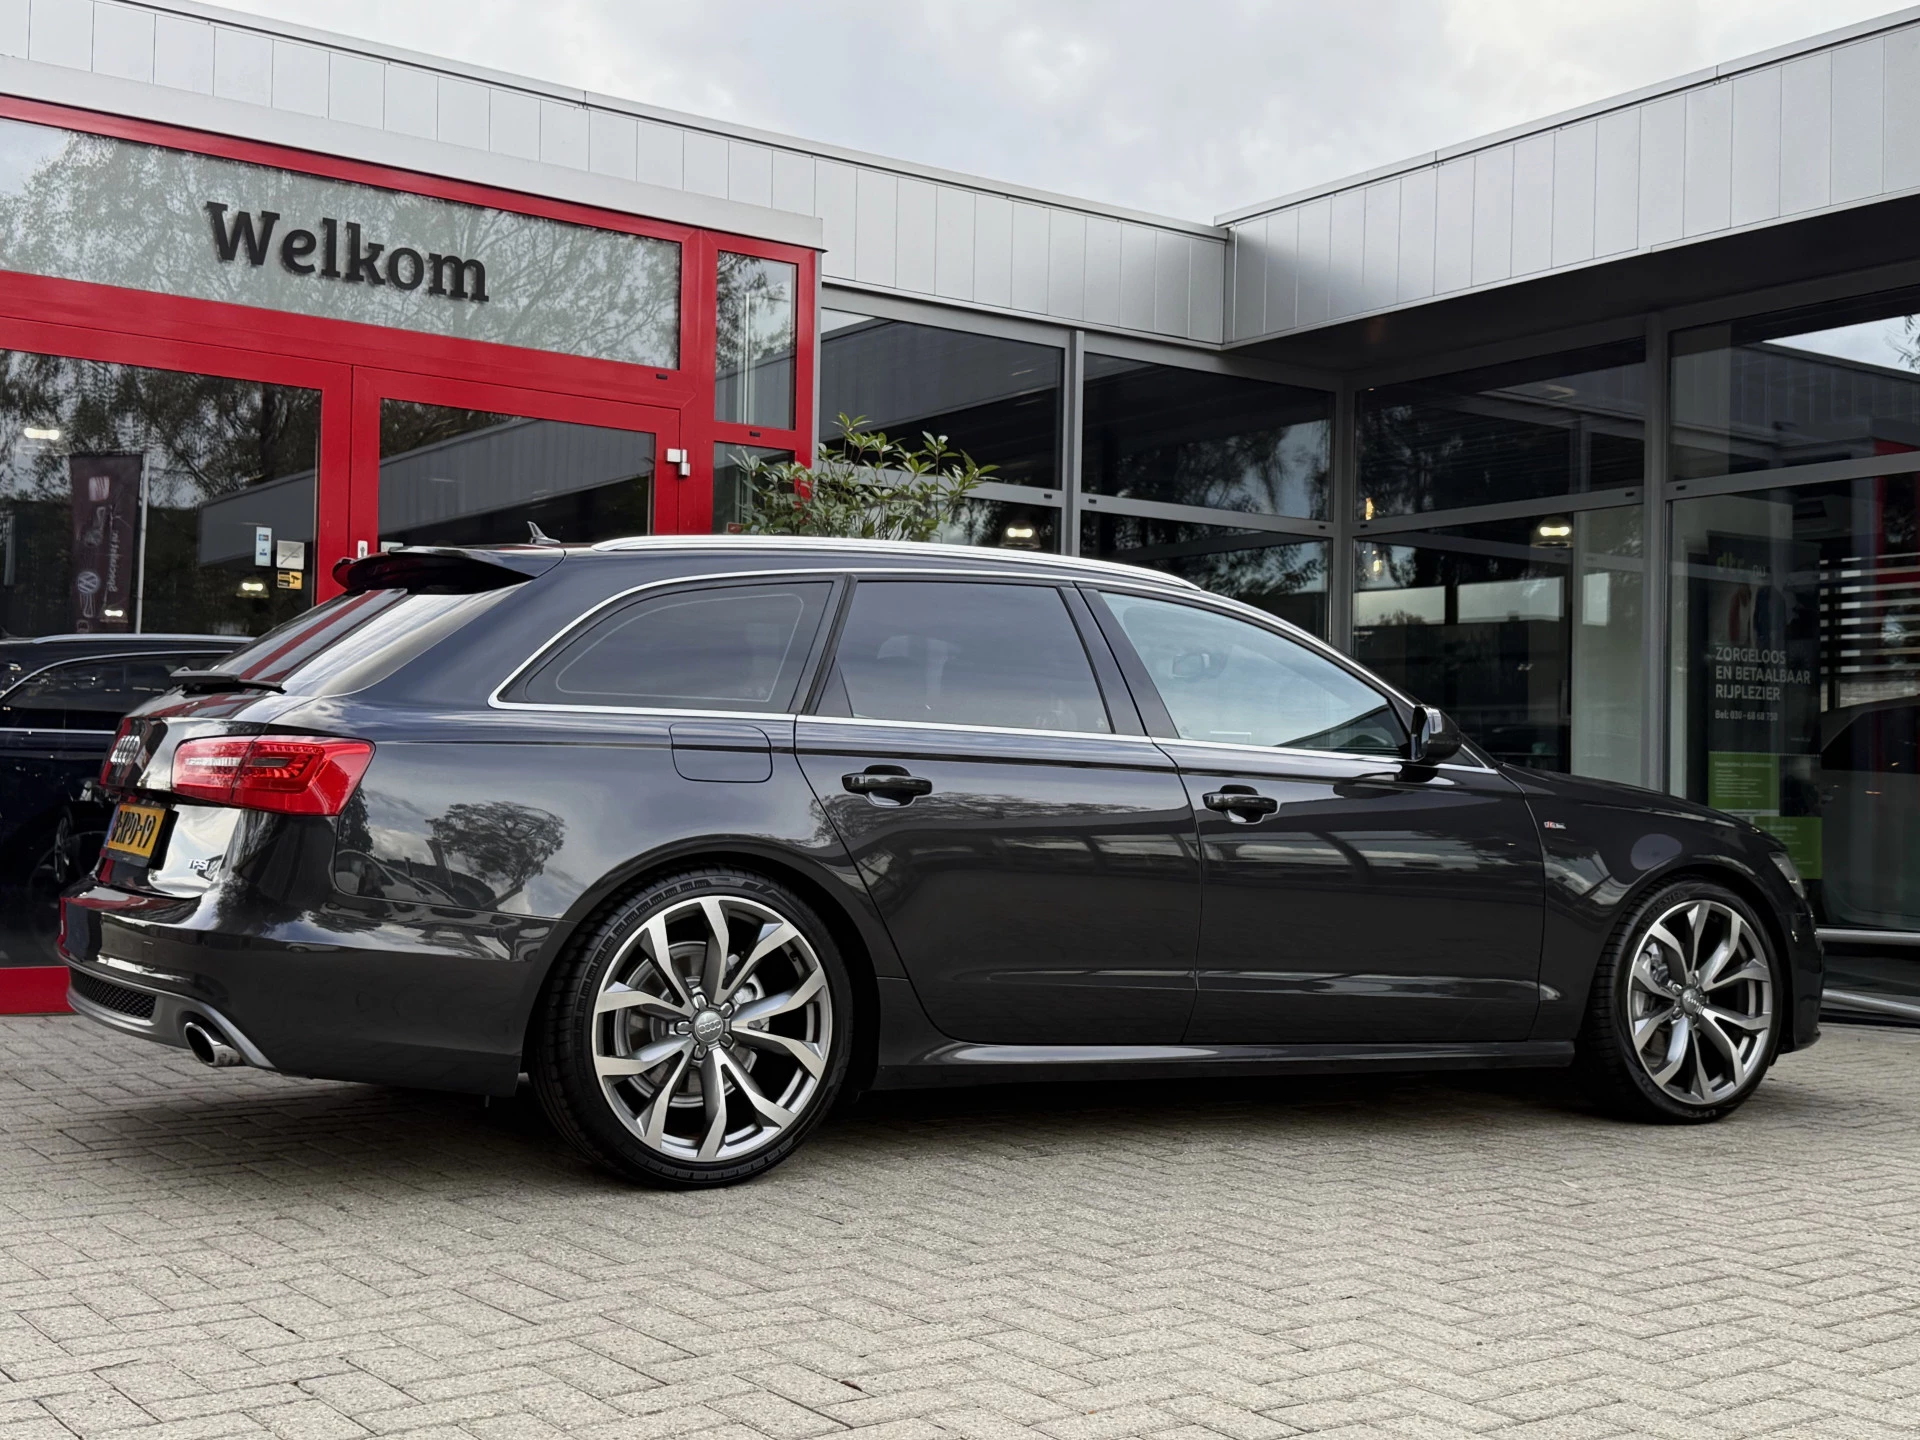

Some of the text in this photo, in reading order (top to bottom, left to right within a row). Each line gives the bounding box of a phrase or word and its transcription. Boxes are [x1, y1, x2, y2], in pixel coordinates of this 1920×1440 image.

[205, 201, 490, 303] Welkom
[1715, 647, 1786, 665] ZORGELOOS
[1715, 666, 1811, 685] EN BETAALBAAR
[1715, 684, 1780, 701] RIJPLEZIER
